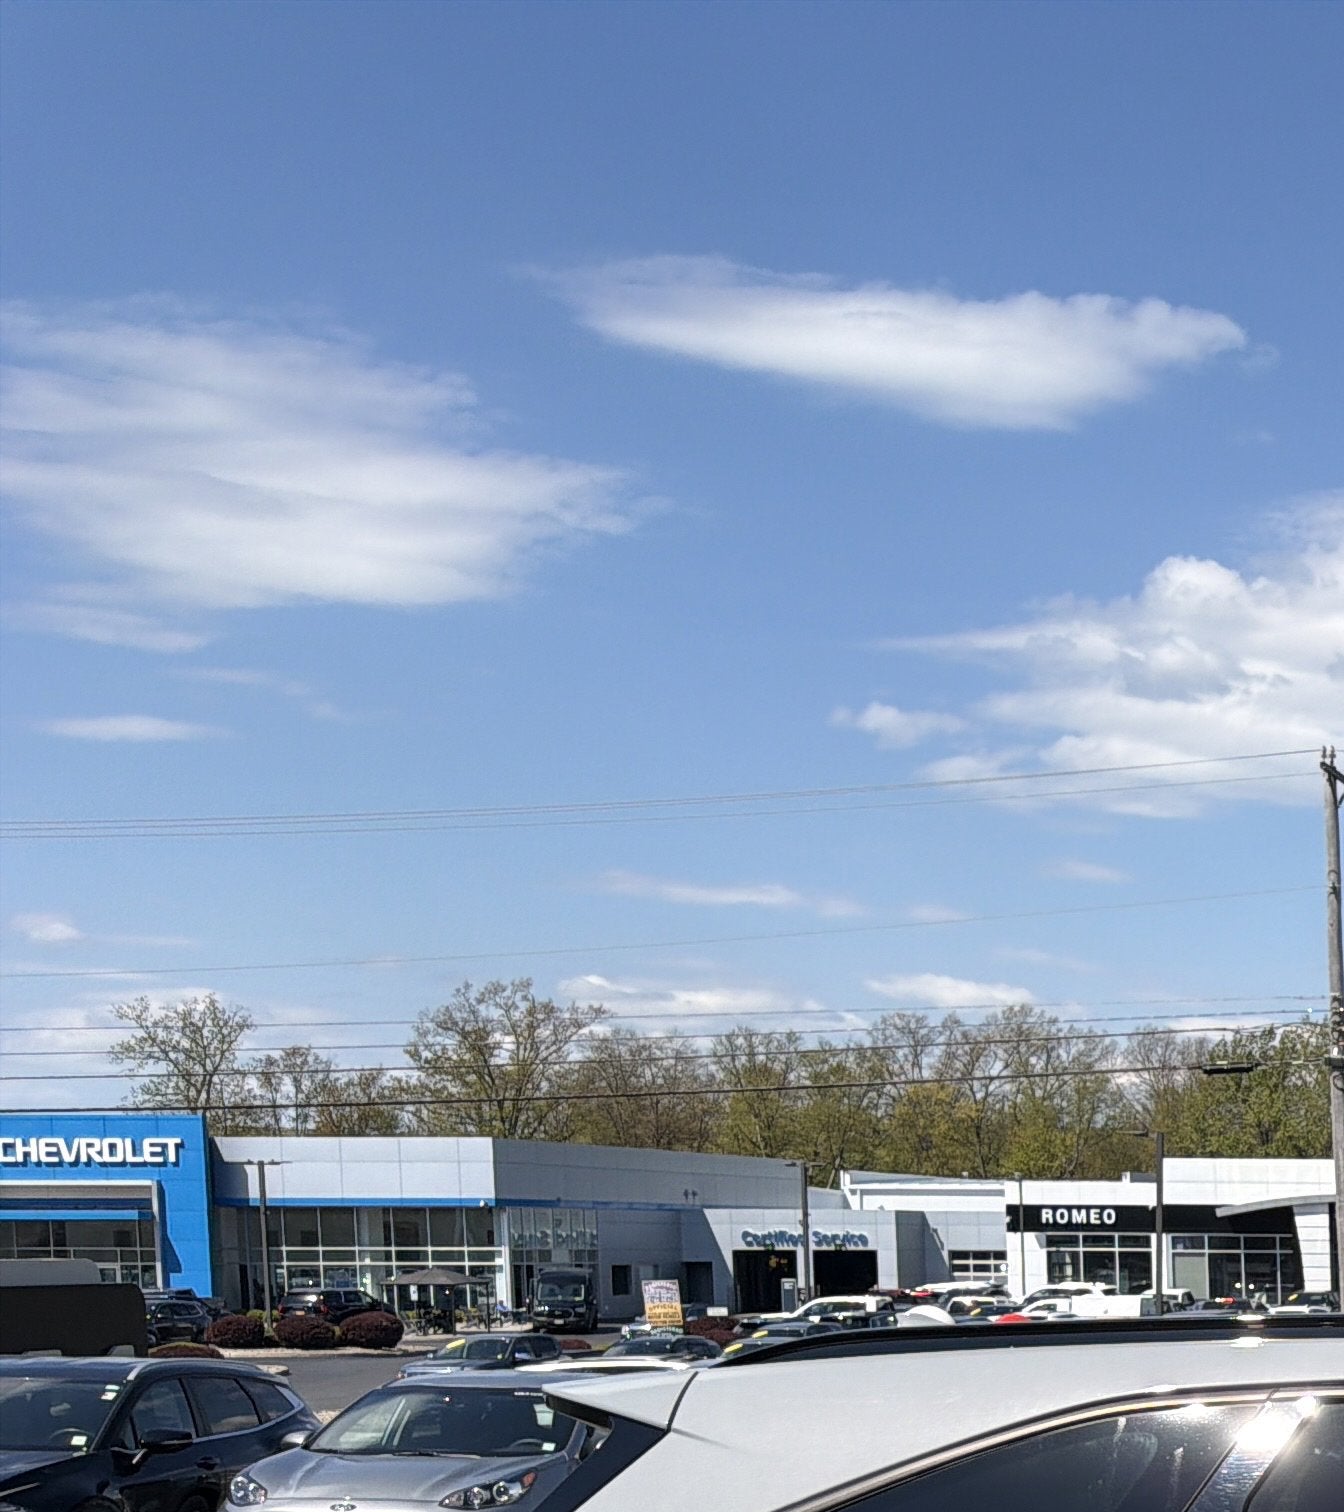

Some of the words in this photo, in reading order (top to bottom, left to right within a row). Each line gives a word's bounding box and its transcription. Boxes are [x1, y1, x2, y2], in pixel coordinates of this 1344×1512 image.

[0, 1137, 182, 1164] CHEVROLET
[1041, 1208, 1116, 1225] ROMEO
[812, 1230, 869, 1248] Service
